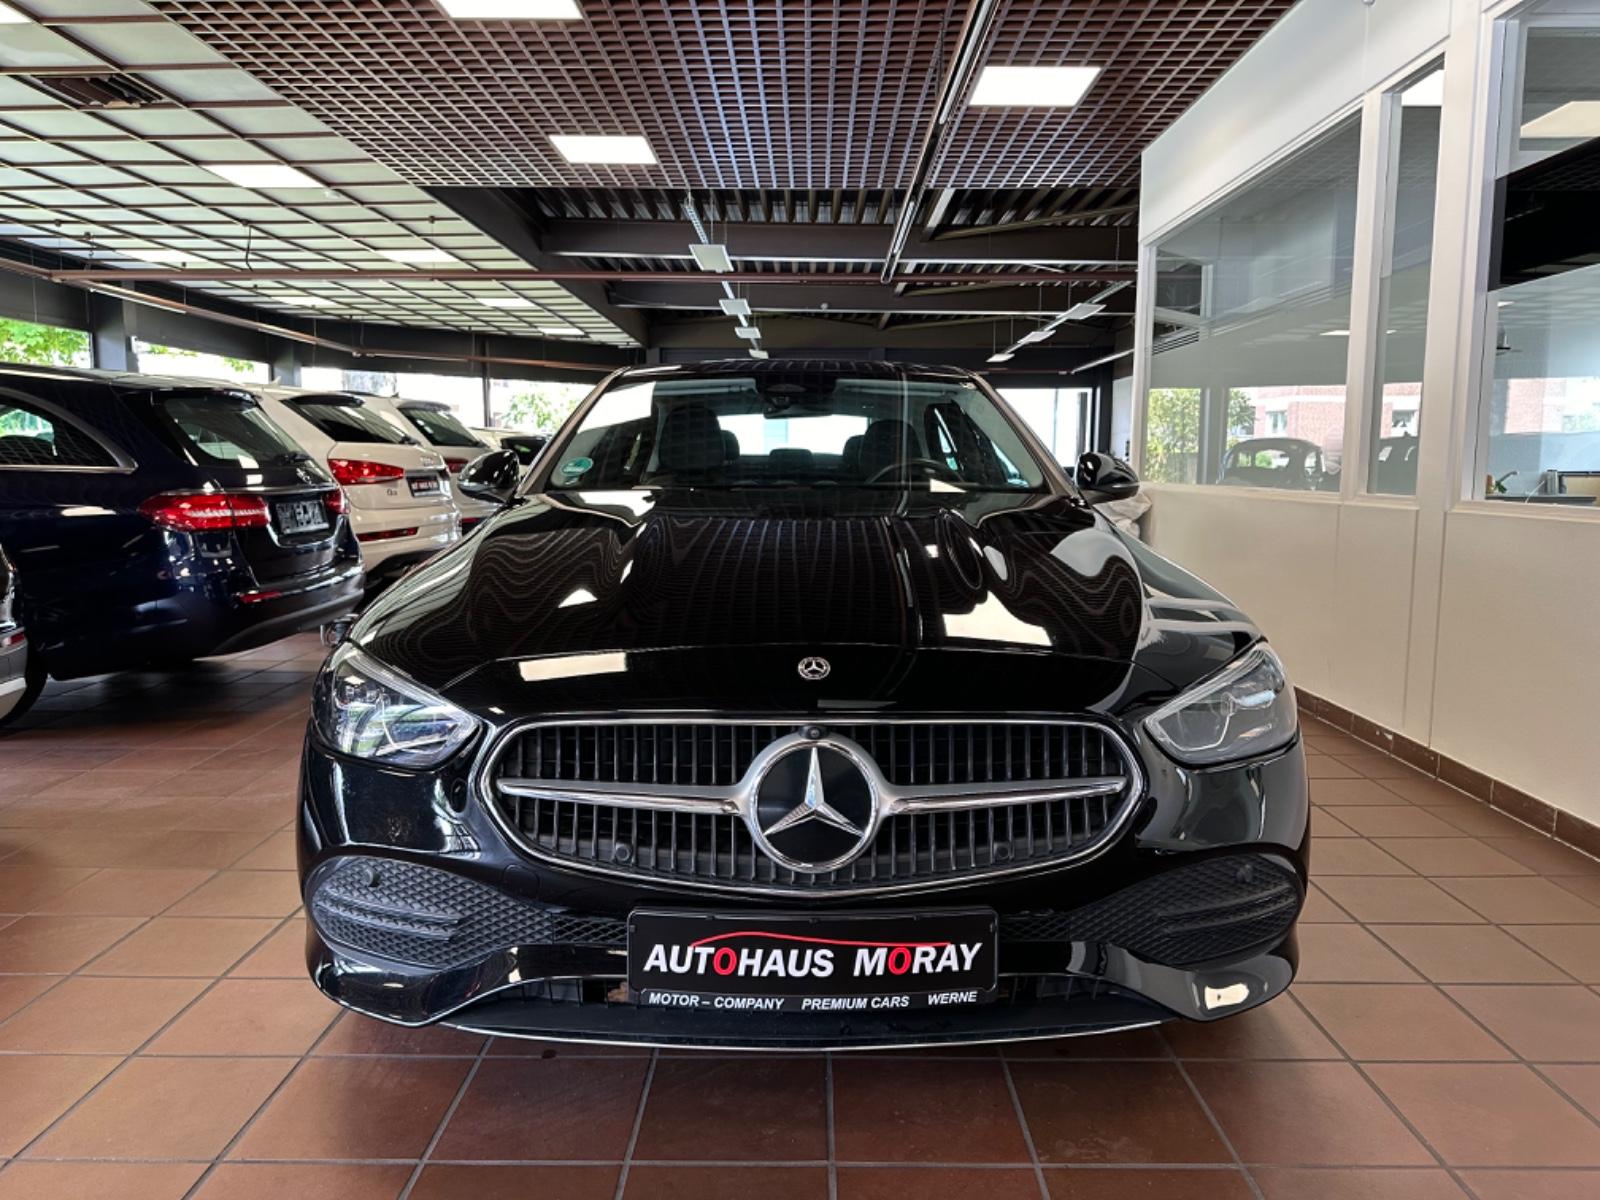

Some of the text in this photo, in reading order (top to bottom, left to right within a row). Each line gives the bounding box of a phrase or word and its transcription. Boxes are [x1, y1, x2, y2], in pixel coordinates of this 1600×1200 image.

[642, 942, 983, 978] AUTOHAUS MORAY
[649, 992, 700, 1007] MOTOR
[713, 996, 784, 1010] COMPANY
[801, 997, 868, 1011] PREMIUM
[870, 996, 910, 1009] CARS
[927, 990, 978, 1006] WERNE
